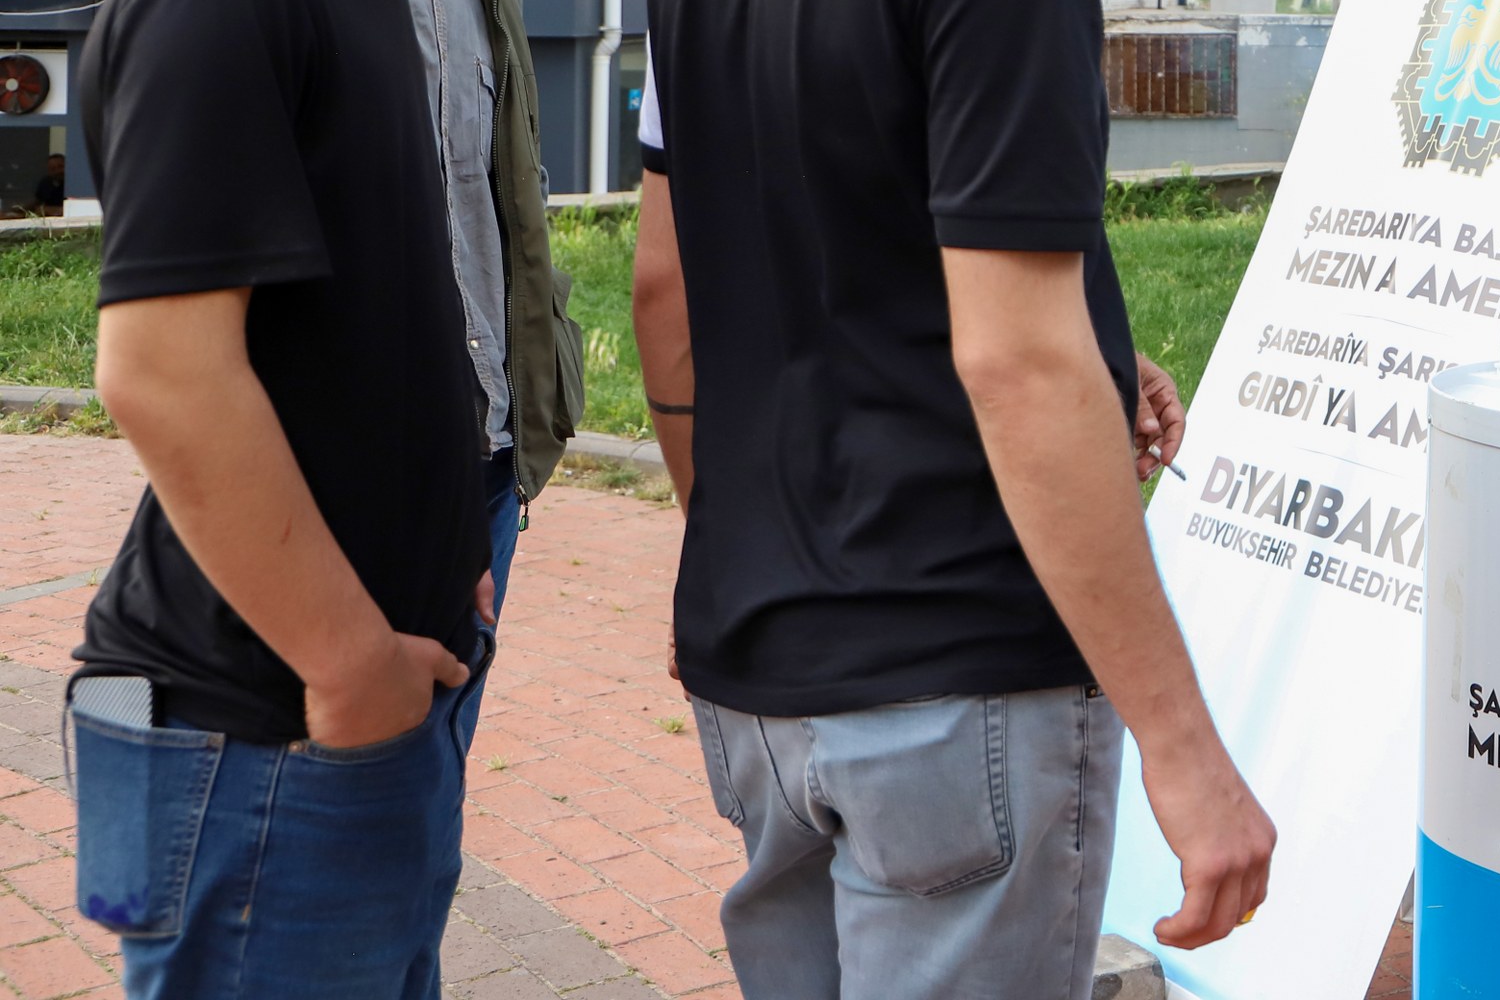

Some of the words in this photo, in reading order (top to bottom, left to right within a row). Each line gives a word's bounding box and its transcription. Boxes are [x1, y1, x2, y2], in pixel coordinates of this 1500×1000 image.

[1286, 247, 1377, 291] MEZIN
[1374, 256, 1398, 294] A
[1257, 324, 1369, 367] ŞAREDARÎYA
[1238, 371, 1323, 422] GIRDÎ
[1322, 387, 1357, 434] YA
[1200, 455, 1425, 571] DİYARBAKI
[1186, 512, 1298, 570] BÜYÜKŞEHİR
[1304, 550, 1424, 616] BELEDİYE
